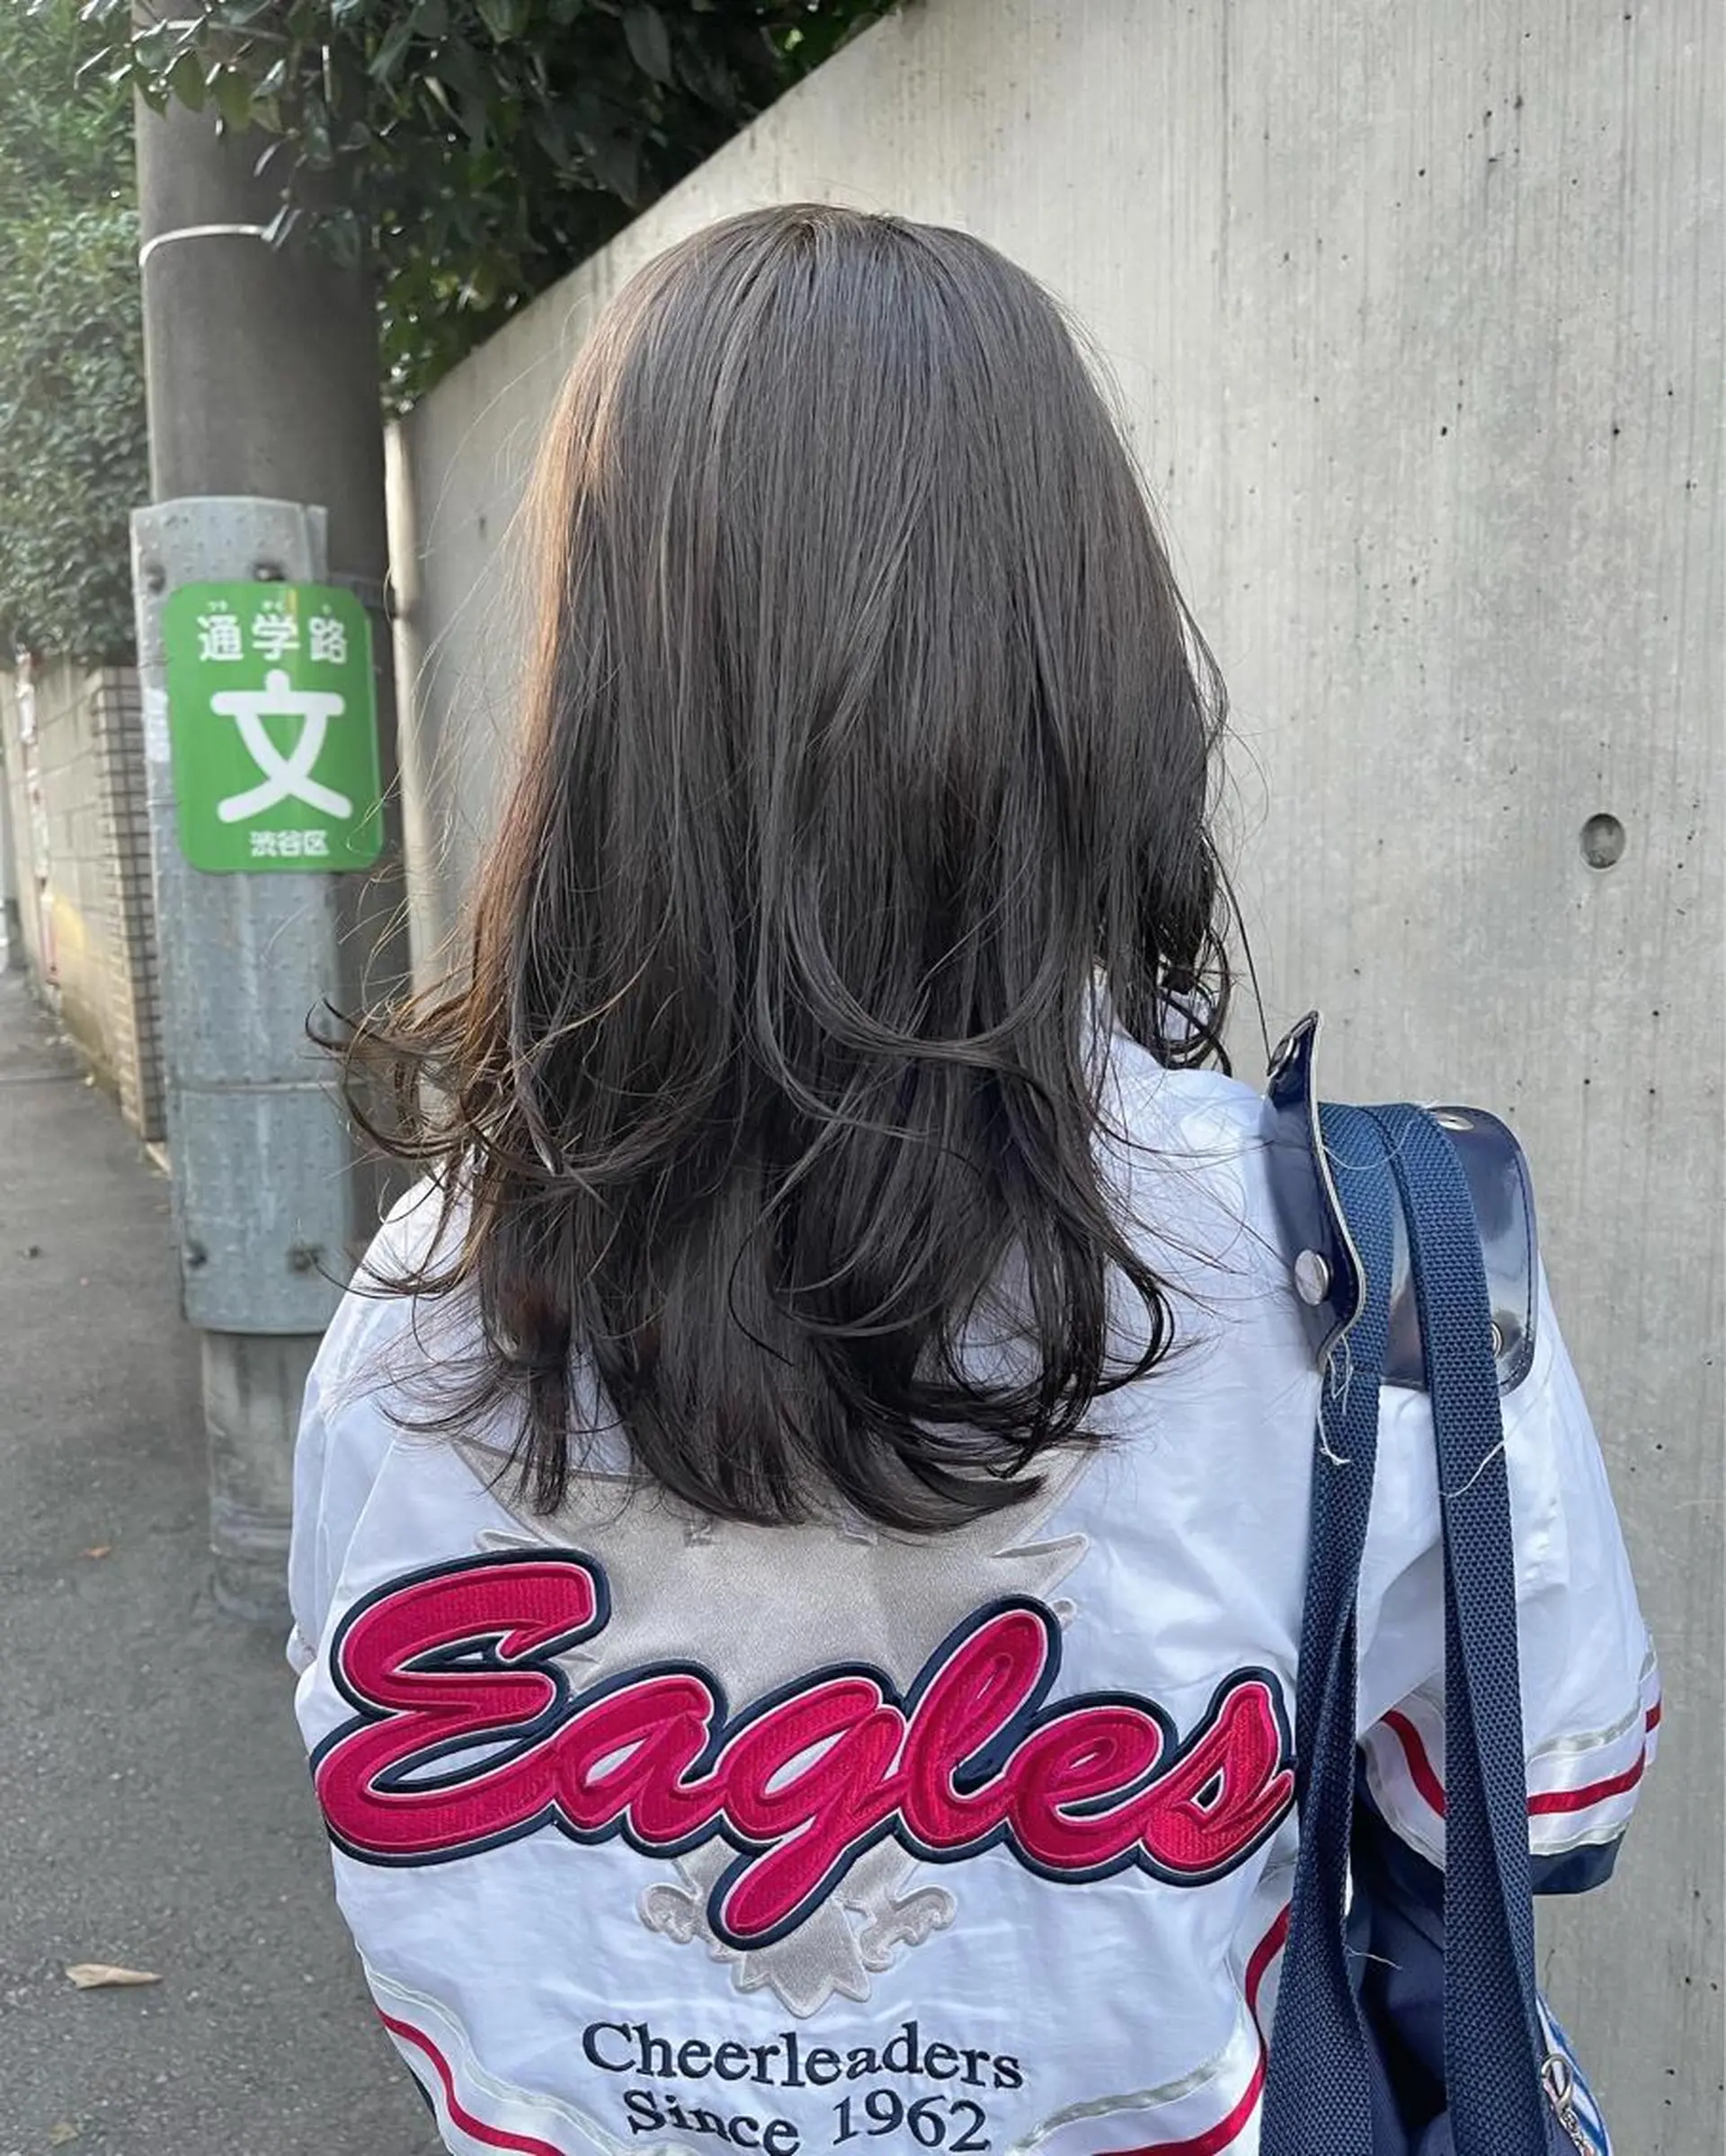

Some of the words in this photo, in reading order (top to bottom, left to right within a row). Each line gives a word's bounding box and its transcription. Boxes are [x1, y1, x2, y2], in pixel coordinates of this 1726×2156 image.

[197, 615, 348, 663] 通学路
[209, 669, 353, 823] 文
[250, 830, 330, 857] 渋谷区
[311, 1547, 1297, 1949] Eagles
[582, 2020, 1025, 2089] Cheerleaders
[622, 2089, 800, 2156] Since
[832, 2089, 991, 2153] 1962
